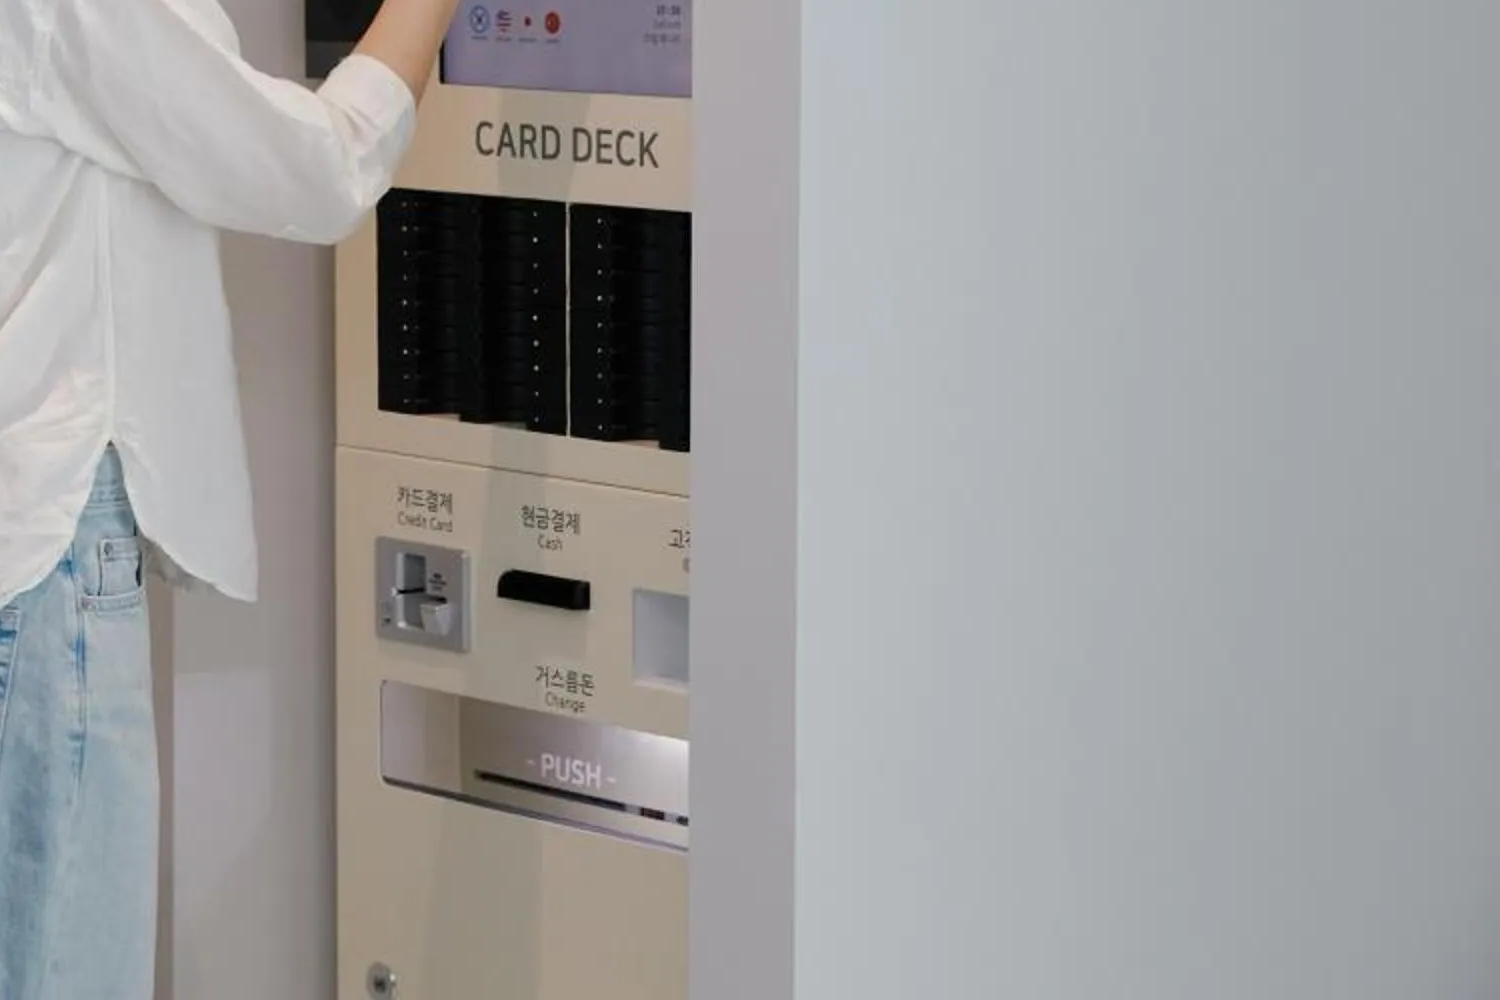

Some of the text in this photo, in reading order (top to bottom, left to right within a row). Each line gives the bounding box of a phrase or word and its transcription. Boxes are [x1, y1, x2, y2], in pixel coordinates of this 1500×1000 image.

[475, 120, 660, 169] CARD DECK
[397, 485, 453, 516] 카드결제
[520, 504, 581, 536] 현금결제
[536, 532, 564, 552] Cash
[534, 664, 595, 698] 거스름돈
[544, 691, 586, 714] Change
